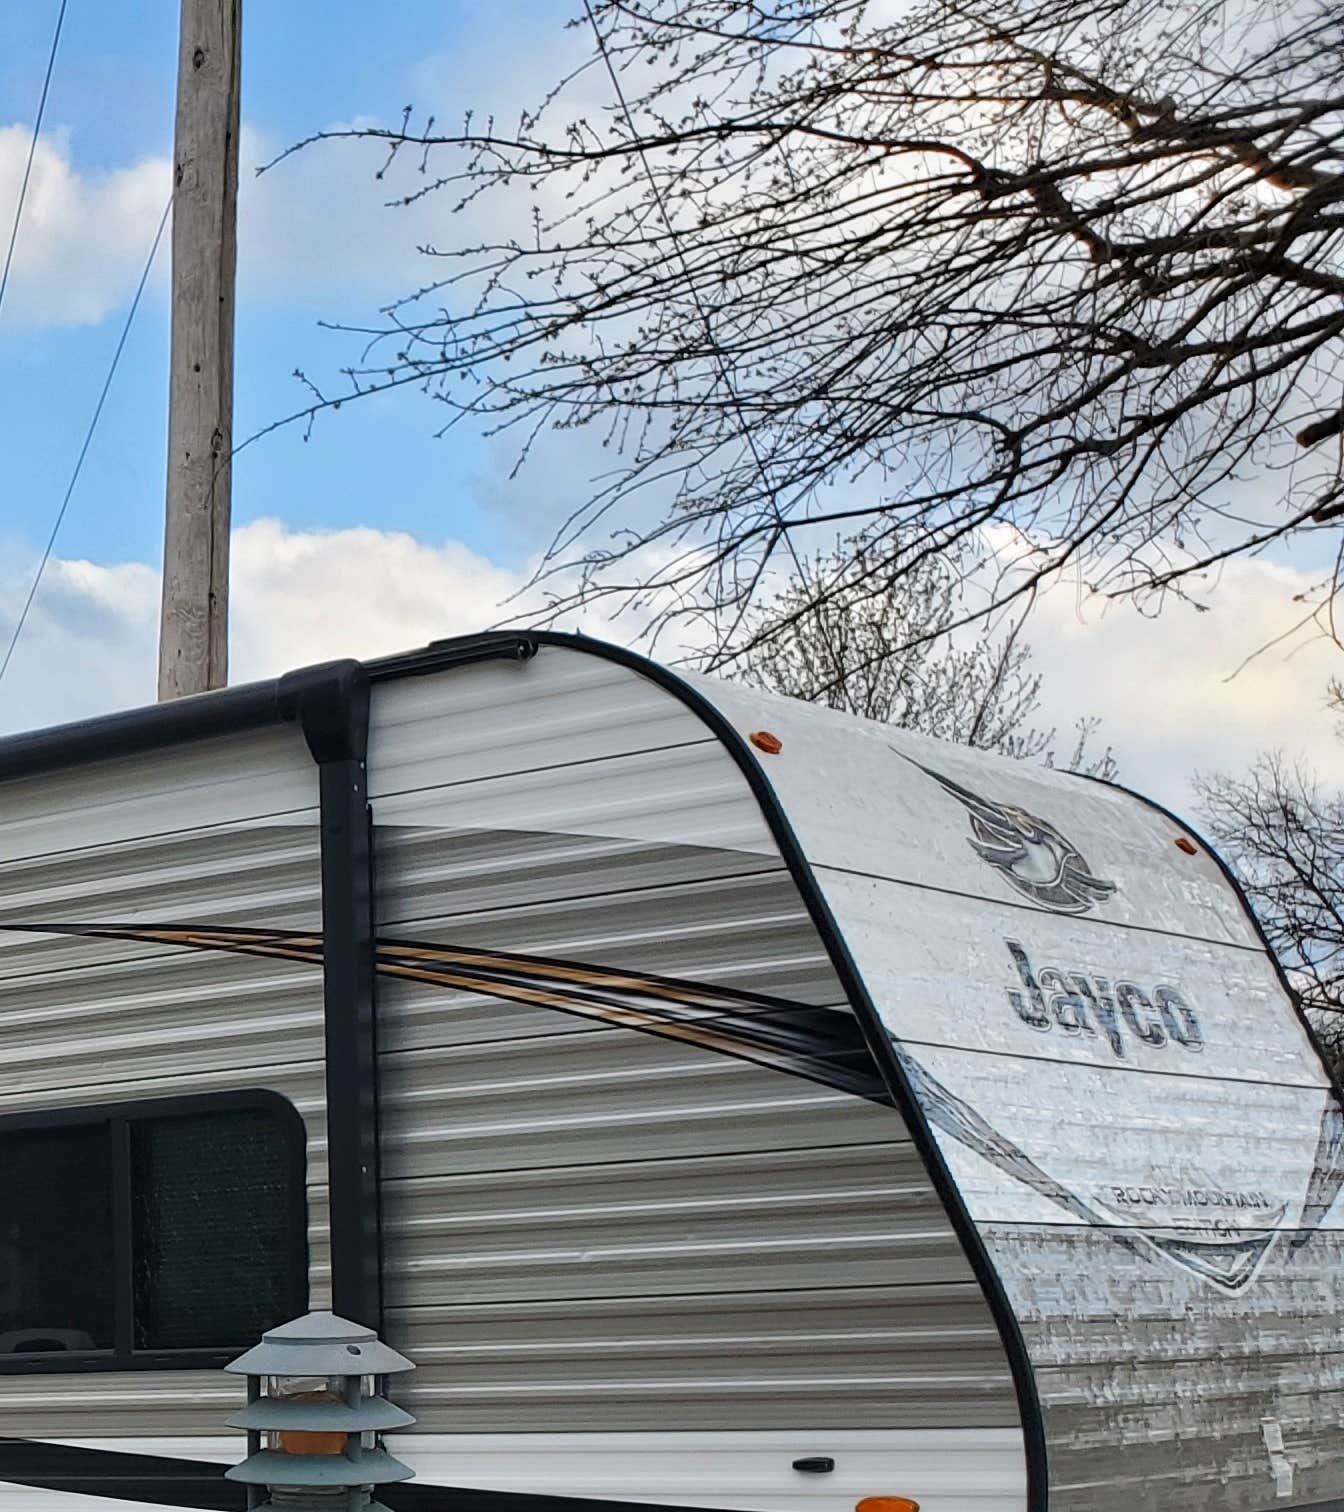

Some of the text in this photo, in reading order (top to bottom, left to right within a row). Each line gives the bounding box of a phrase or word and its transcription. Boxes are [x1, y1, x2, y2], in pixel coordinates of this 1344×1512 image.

[1003, 937, 1204, 1059] Jayco
[1111, 1187, 1272, 1209] ROCKY MOUNTAIN
